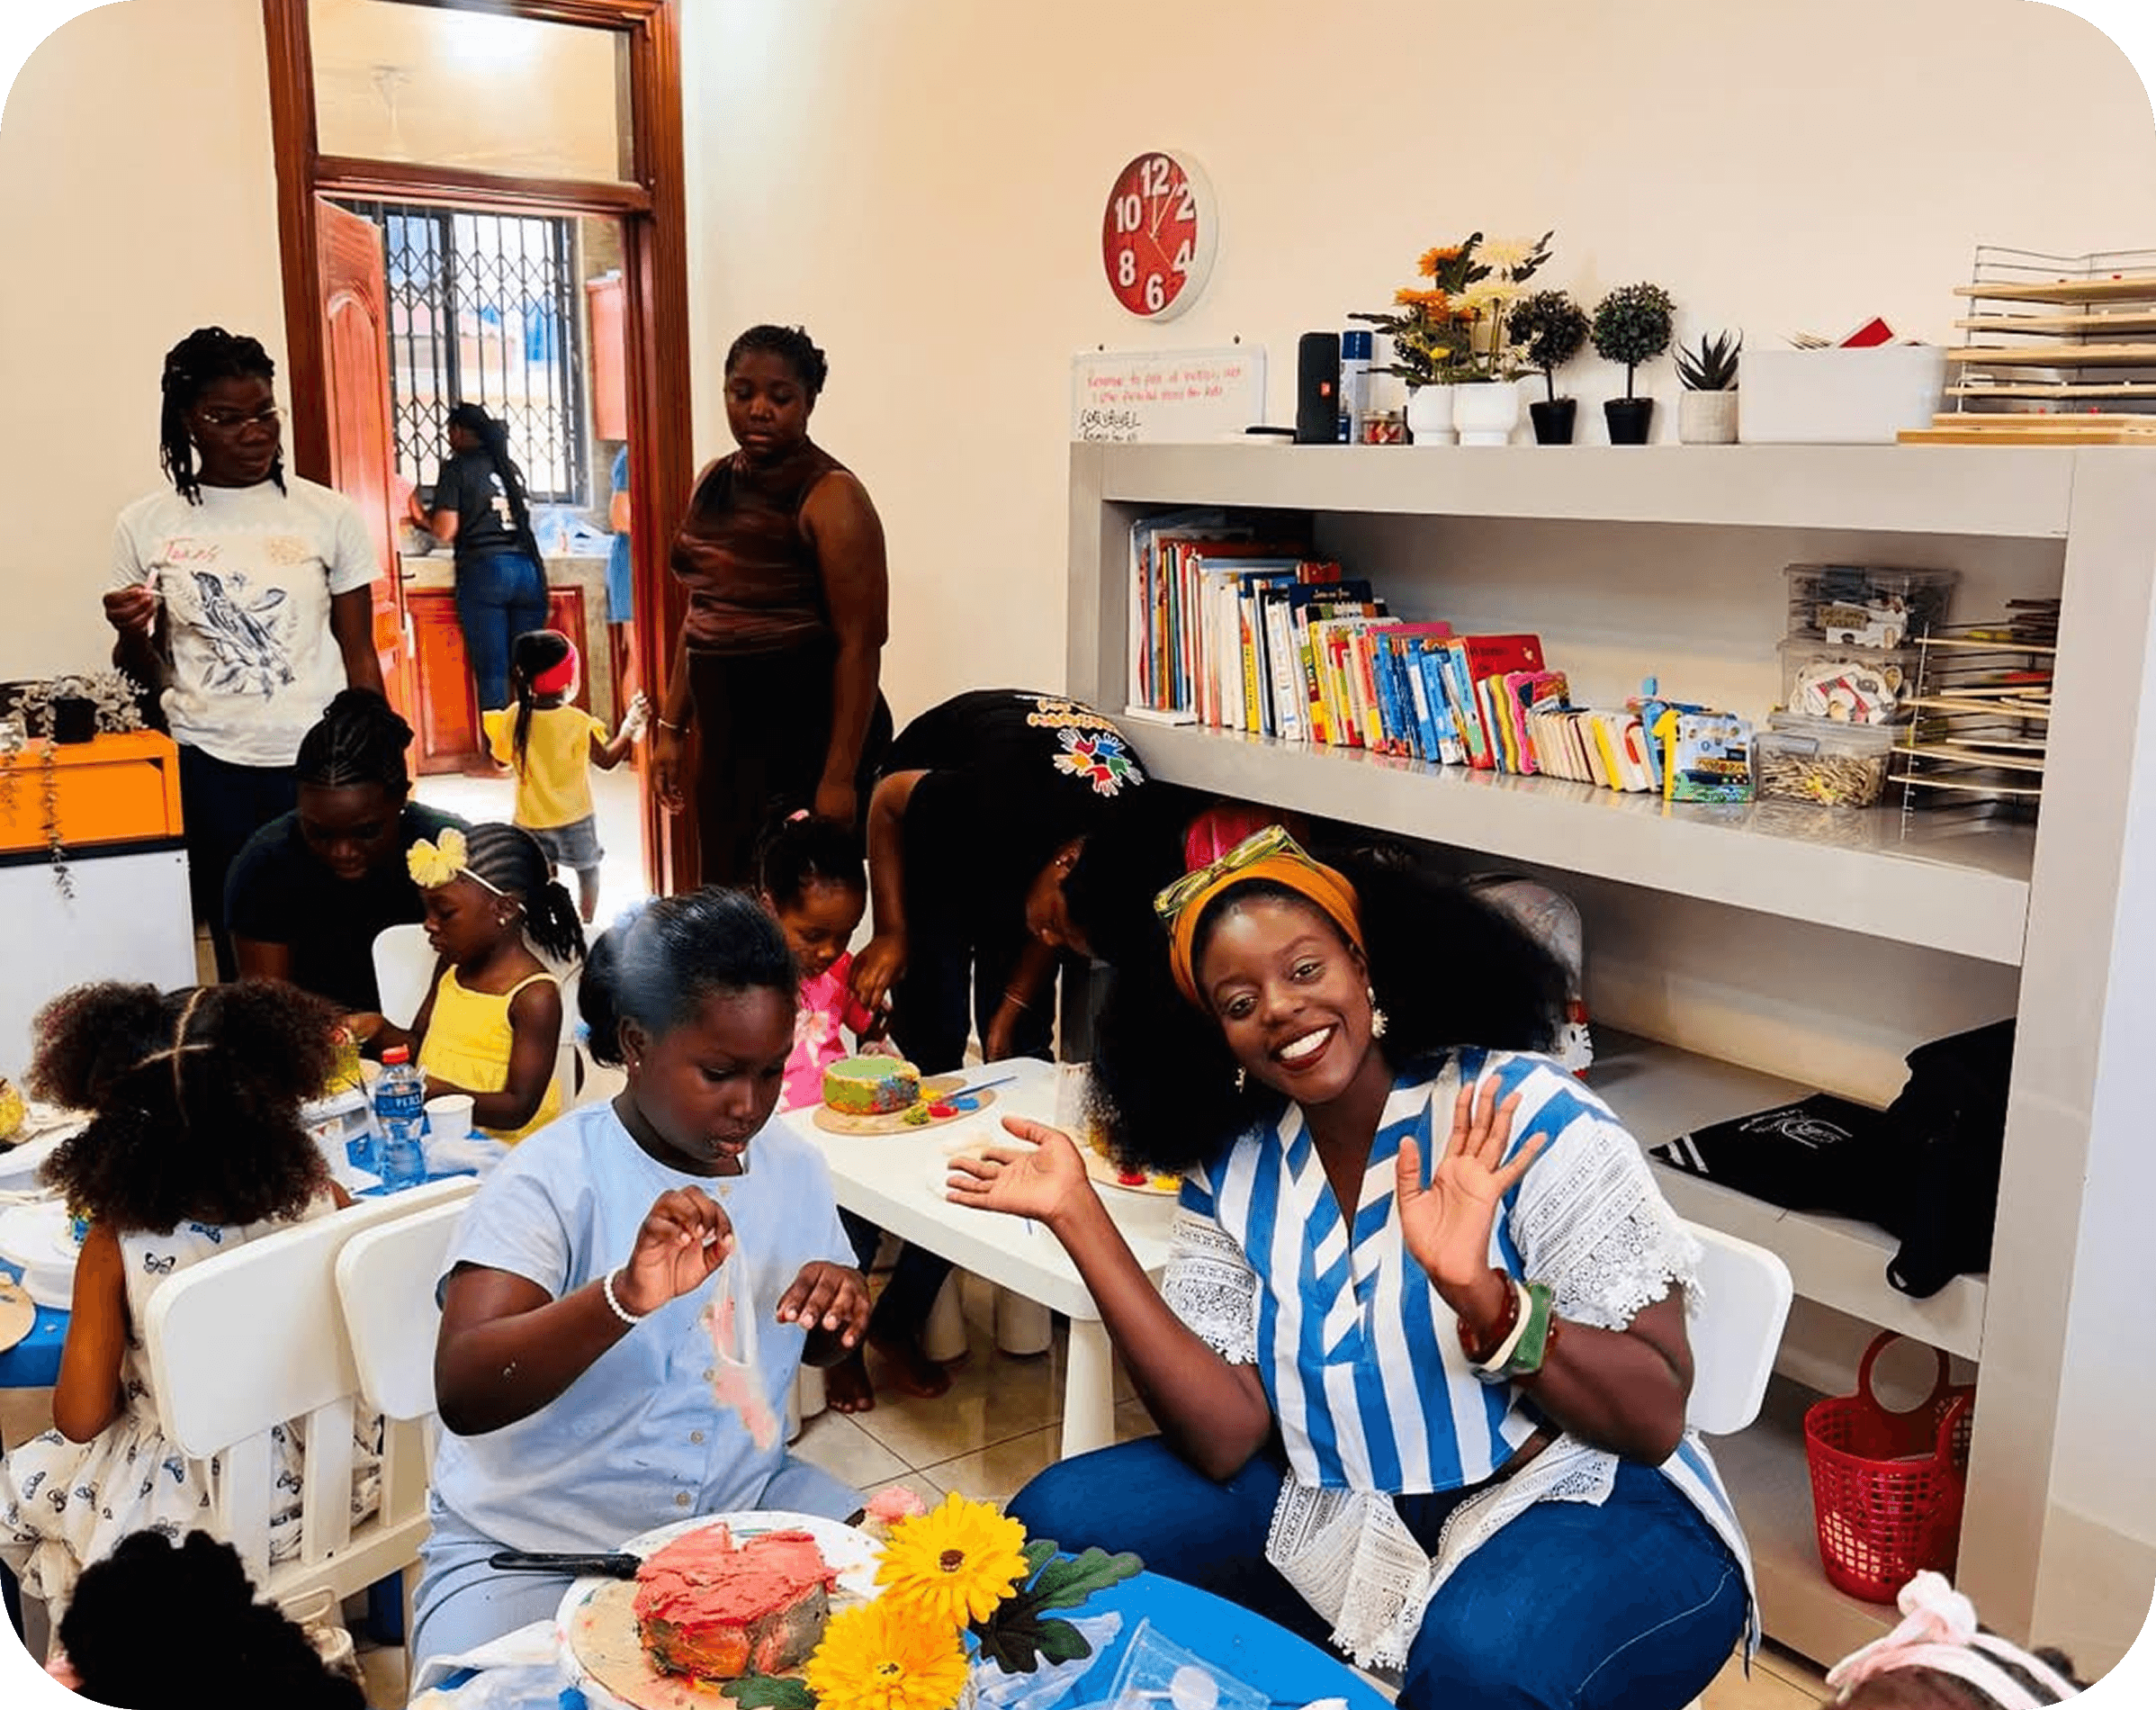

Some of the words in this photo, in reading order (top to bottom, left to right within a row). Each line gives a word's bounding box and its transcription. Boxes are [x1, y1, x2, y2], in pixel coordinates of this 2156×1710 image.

[1140, 157, 1170, 197] 12
[1114, 193, 1142, 233] 10
[1175, 182, 1195, 222] 2
[1118, 248, 1136, 287] 8
[1172, 238, 1193, 275] 4
[1145, 273, 1164, 310] 6
